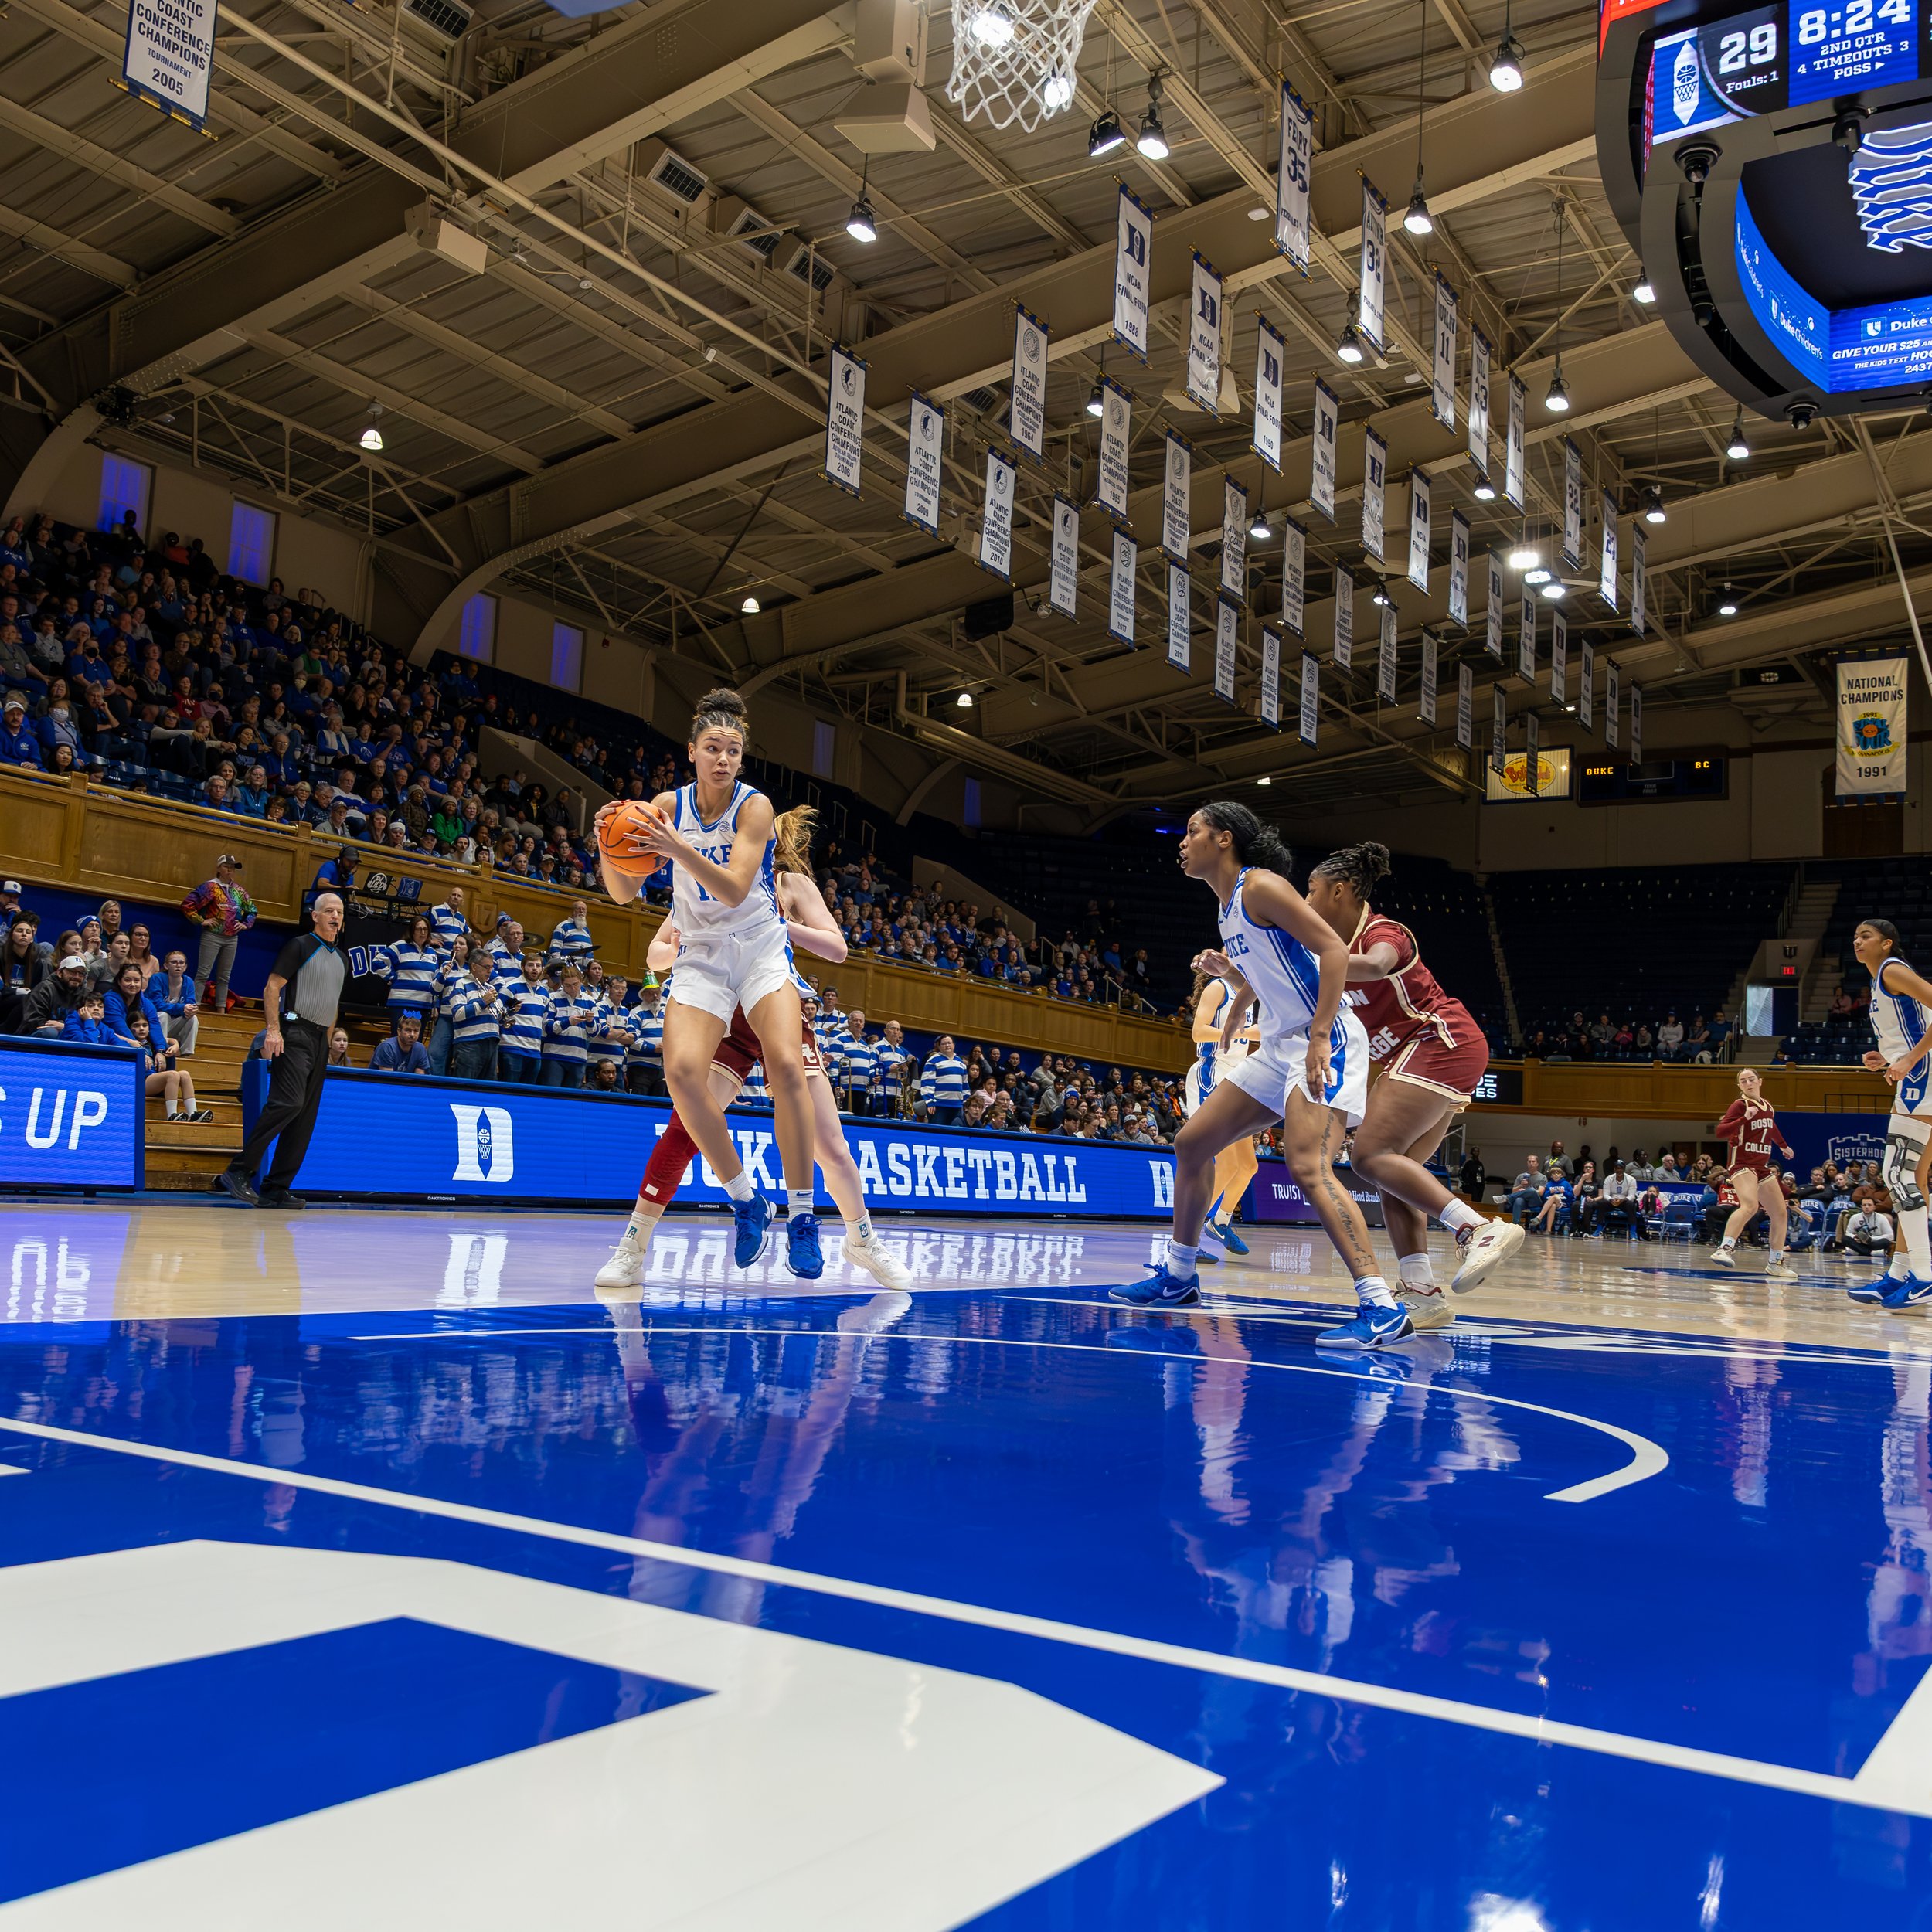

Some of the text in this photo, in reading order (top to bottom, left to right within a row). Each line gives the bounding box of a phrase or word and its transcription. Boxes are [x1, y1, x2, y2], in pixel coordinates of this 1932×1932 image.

[157, 0, 194, 29] COAST
[1798, 0, 1910, 45] 8:24
[136, 3, 211, 56] CONFERENCE
[138, 22, 206, 70] CHAMPIONS
[1719, 22, 1777, 75] 29
[1821, 32, 1886, 56] 2ND QTR
[148, 47, 192, 78] TOURNAMENT
[1797, 41, 1910, 74] 4 TIMEOUTS 3
[152, 68, 183, 96] 2005
[1833, 63, 1871, 80] POSS
[1726, 73, 1768, 94] Fouls:
[1287, 146, 1308, 194] 35
[1366, 239, 1381, 283] 32
[1127, 271, 1141, 292] NCAA
[1117, 283, 1134, 308] FINAL
[1124, 319, 1138, 338] 1988
[1890, 318, 1927, 332] Duke
[1199, 333, 1213, 352] NCAA
[1780, 312, 1823, 361] Duke Children's
[1440, 331, 1450, 365] 11
[1832, 348, 1862, 360] GIVE
[1862, 342, 1897, 356] YOUR
[1899, 339, 1920, 351] $25
[1869, 359, 1888, 368] KIDS
[1888, 356, 1909, 365] TEXT
[1021, 366, 1040, 387] ATLANTIC
[1022, 379, 1037, 394] COAST
[1015, 385, 1043, 413] CONFERENCE
[836, 401, 858, 423] ATLANTIC
[1015, 397, 1042, 423] CHAMPIONS
[838, 414, 855, 430] COAST
[830, 420, 862, 447] CONFERENCE
[1021, 427, 1034, 444] 1964
[1107, 433, 1124, 452] ATLANTIC
[831, 434, 860, 457] CHAMPIONS
[915, 446, 937, 465] ATLANTIC
[1109, 445, 1122, 461] COAST
[837, 462, 851, 478] 2006
[919, 458, 933, 474] COAST
[1101, 451, 1128, 475] CONFERENCE
[909, 464, 939, 489] CONFERENCE
[1103, 463, 1127, 486] CHAMPIONS
[910, 476, 937, 498] CHAMPIONS
[1170, 482, 1186, 500] ATLANTIC
[917, 502, 929, 518] 2009
[989, 498, 1009, 517] ATLANTIC
[993, 509, 1005, 525] COAST
[1165, 500, 1189, 522] CONFERENCE
[985, 515, 1011, 539] CONFERENCE
[985, 526, 1010, 548] CHAMPIONS
[990, 552, 1003, 566] 2010
[1060, 593, 1070, 605] 2011
[1847, 675, 1898, 690] NATIONAL
[1841, 689, 1903, 705] CHAMPIONS
[1586, 767, 1614, 776] DUKE
[1856, 766, 1887, 778] 1991
[1471, 1087, 1497, 1098] ES
[26, 1087, 108, 1151] UP
[450, 1104, 514, 1182] D
[1760, 1128, 1767, 1144] 1
[844, 1139, 1087, 1202] ASKETBALL
[1272, 1183, 1301, 1200] TRUIST
[1352, 1190, 1366, 1202] Hotel
[1366, 1192, 1381, 1203] Brands
[1673, 1193, 1691, 1202] DUKE
[1801, 1199, 1819, 1209] DUKE
[1354, 1253, 1376, 1269] 222
